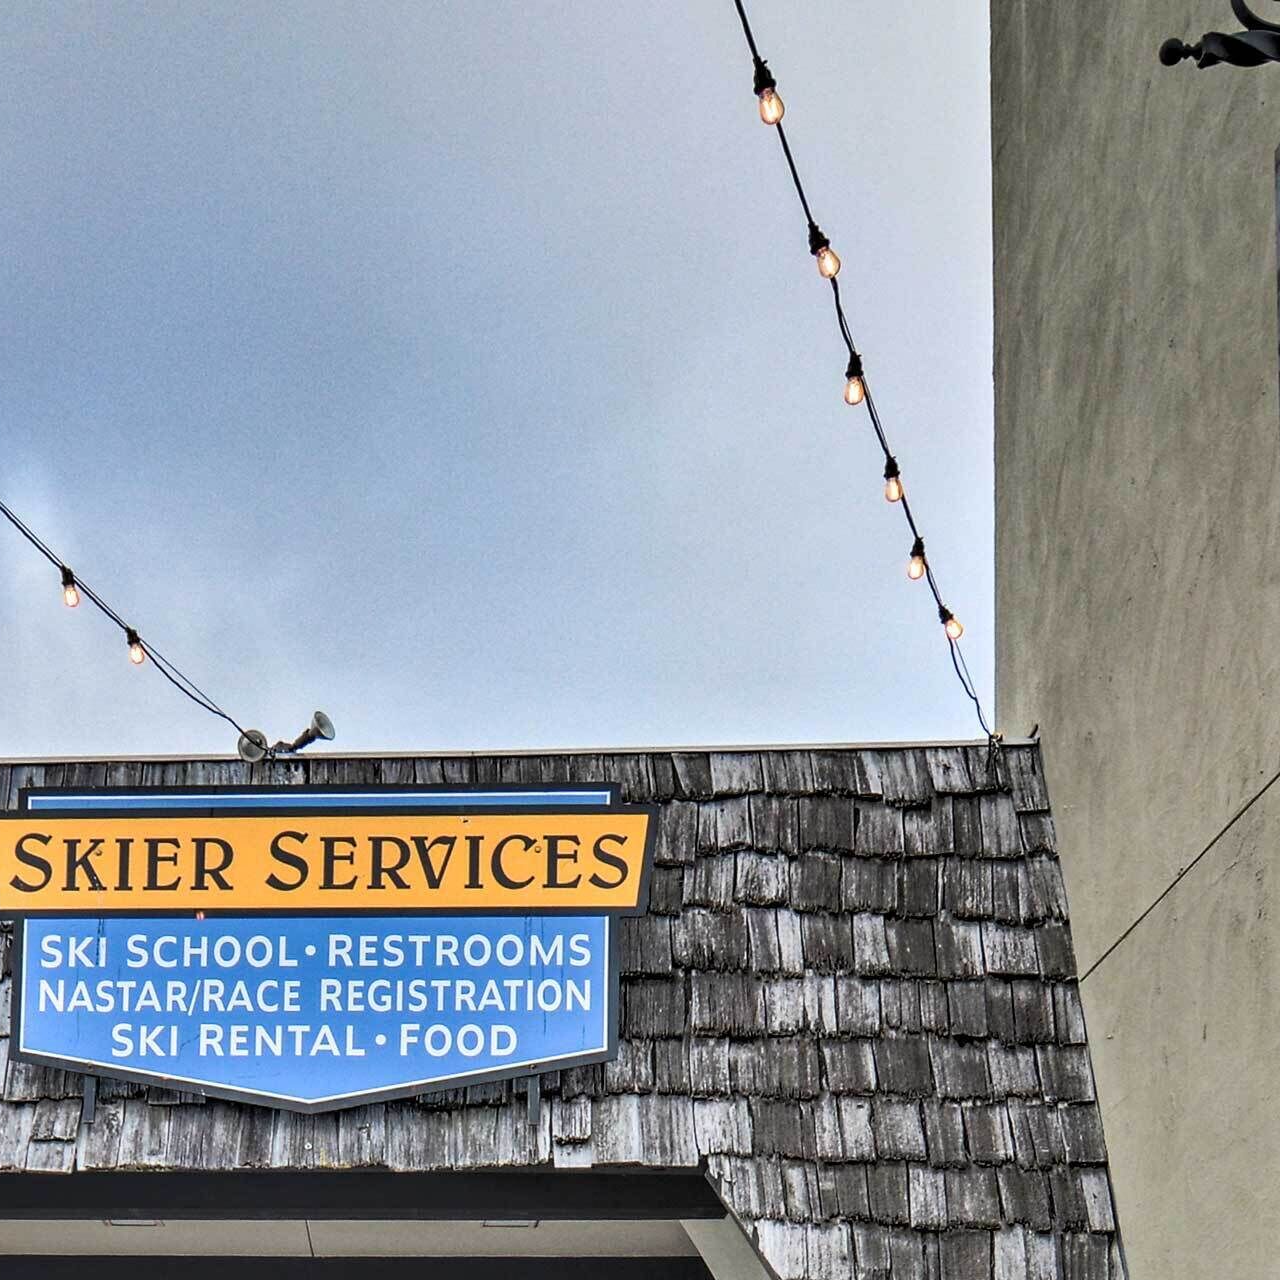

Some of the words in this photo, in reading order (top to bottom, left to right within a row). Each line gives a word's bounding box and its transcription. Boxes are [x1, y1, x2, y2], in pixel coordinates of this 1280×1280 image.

[9, 832, 234, 893] SKIER
[265, 830, 629, 892] SERVICES
[40, 934, 108, 969] SKI
[127, 934, 298, 968] SCHOOL
[328, 934, 591, 967] RESTROOMS
[38, 979, 301, 1017] NASTAR/RACE
[320, 978, 591, 1012] REGISTRATION
[111, 1023, 178, 1058] SKI
[199, 1023, 366, 1057] RENTAL
[400, 1023, 518, 1057] FOOD
